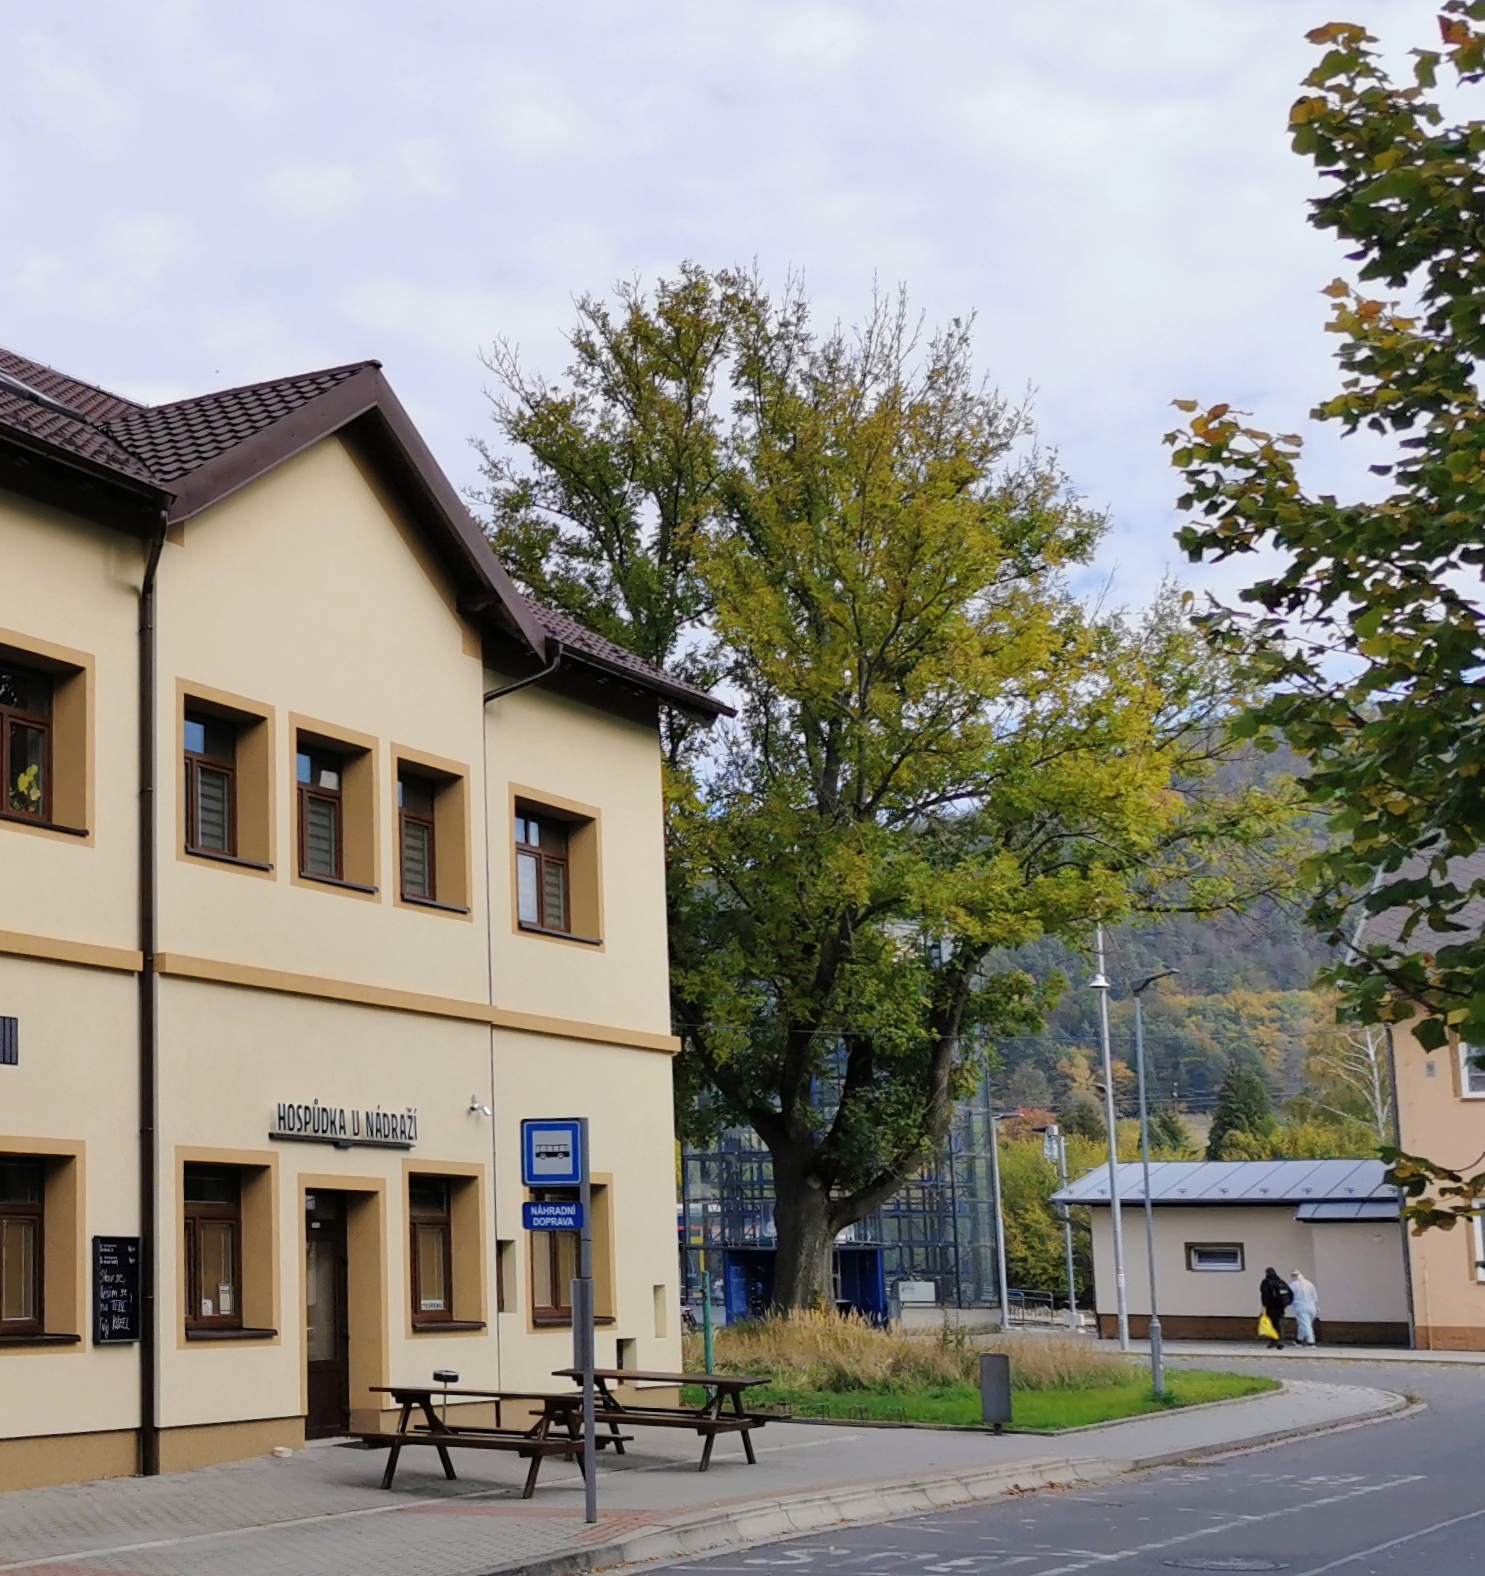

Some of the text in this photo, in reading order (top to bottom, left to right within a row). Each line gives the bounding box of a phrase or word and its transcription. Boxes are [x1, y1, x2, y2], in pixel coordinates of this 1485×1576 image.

[277, 1098, 418, 1140] HOSPŮDKA U NÁDRAŽÍ
[531, 1204, 576, 1215] NÁHRADNÍ
[532, 1217, 574, 1227] DOPRAVA
